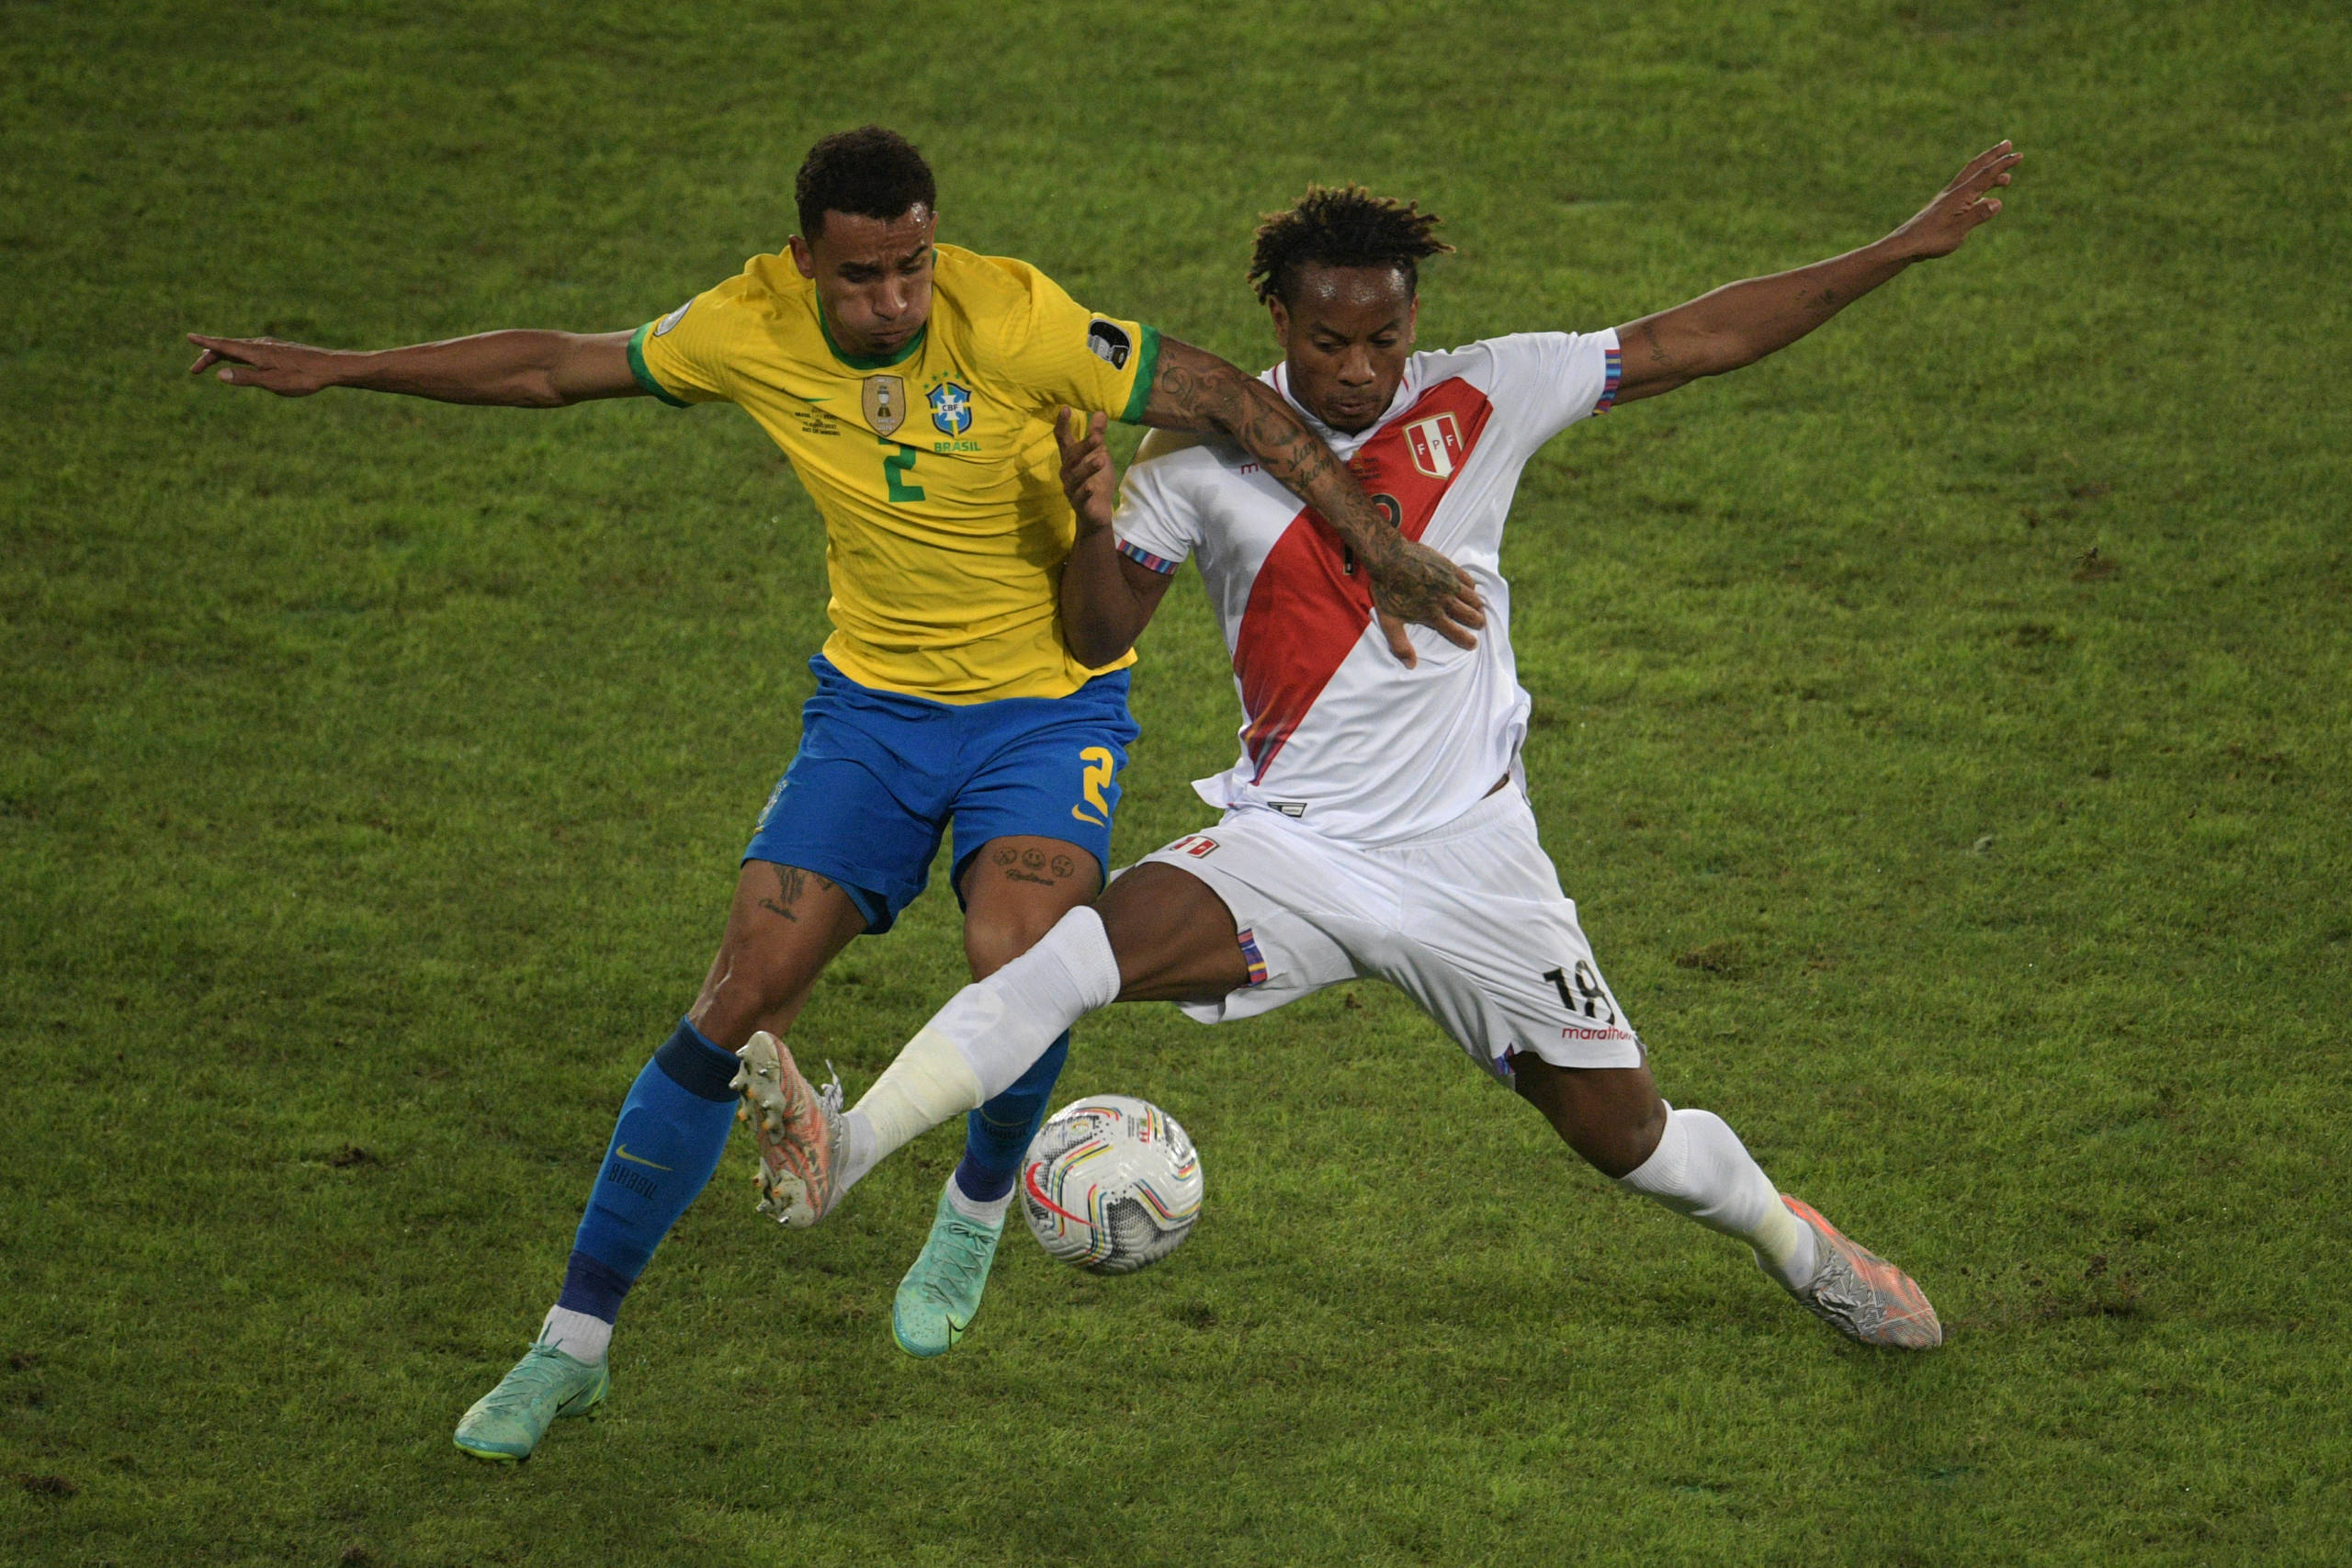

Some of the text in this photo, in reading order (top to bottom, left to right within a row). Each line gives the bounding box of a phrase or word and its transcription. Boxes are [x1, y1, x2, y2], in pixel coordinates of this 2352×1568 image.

[878, 436, 926, 502] 2
[934, 442, 982, 453] BRASIL
[1080, 746, 1114, 818] 2
[1543, 960, 1615, 1026] 18
